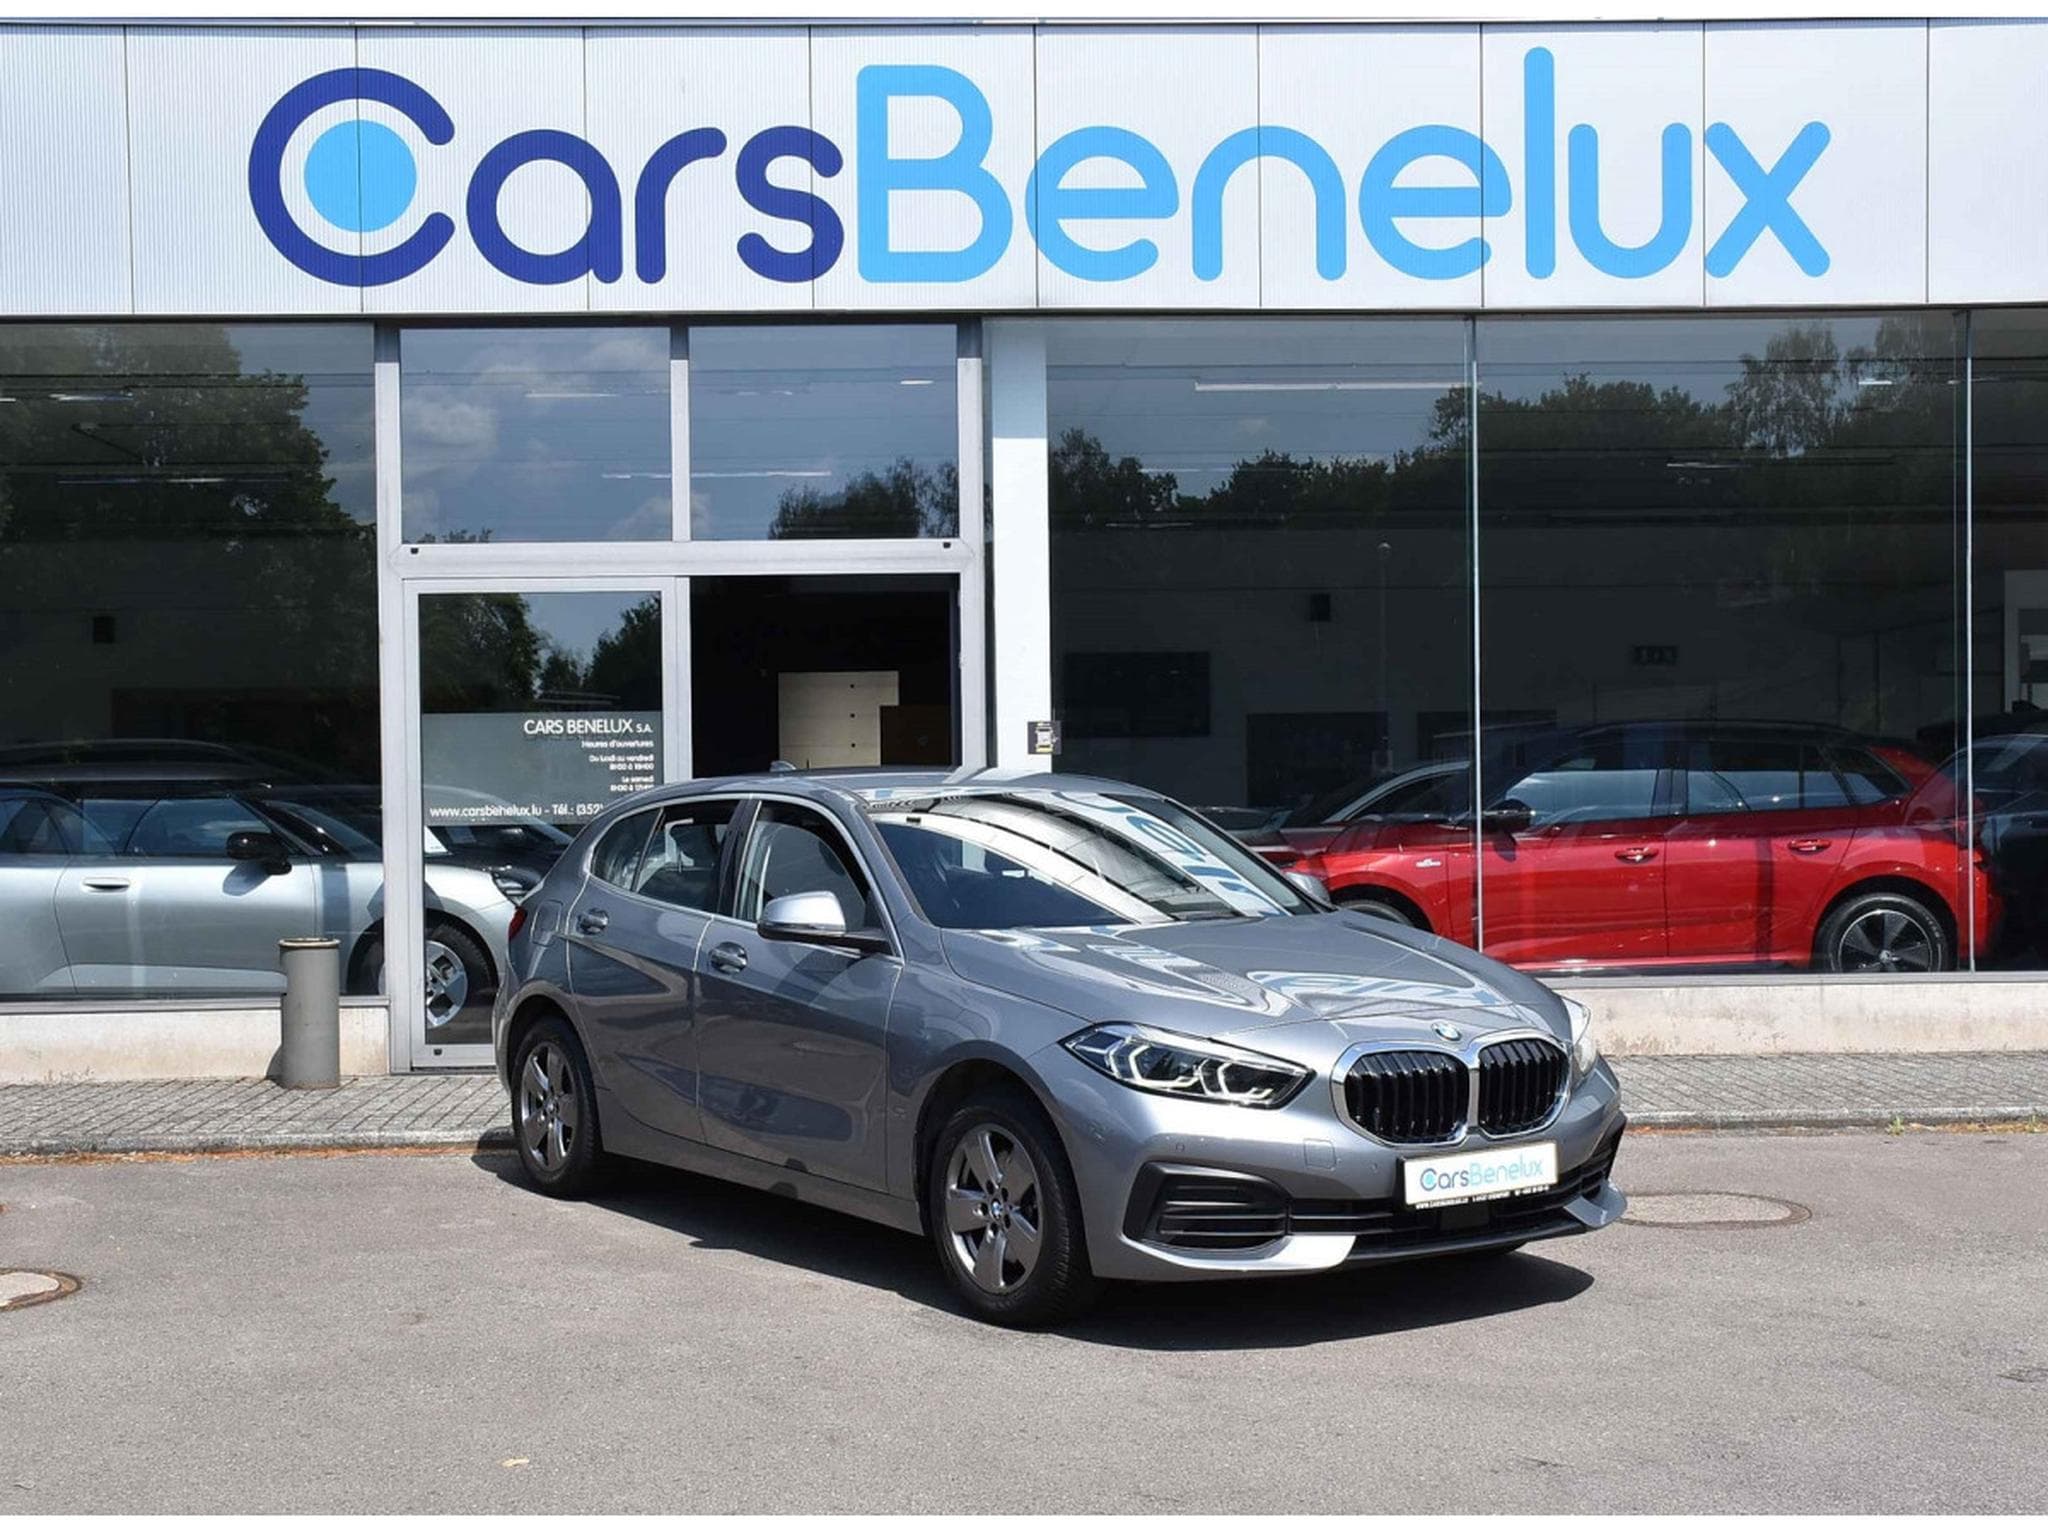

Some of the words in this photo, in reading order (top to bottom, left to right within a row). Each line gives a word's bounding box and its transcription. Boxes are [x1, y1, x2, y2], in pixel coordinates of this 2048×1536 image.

[248, 47, 1831, 287] CarsBenelux
[524, 719, 564, 735] CARS
[566, 718, 634, 734] BENELUX
[430, 804, 542, 817] www.carsbenelux.lu
[1420, 1154, 1543, 1191] CarsBenelux
